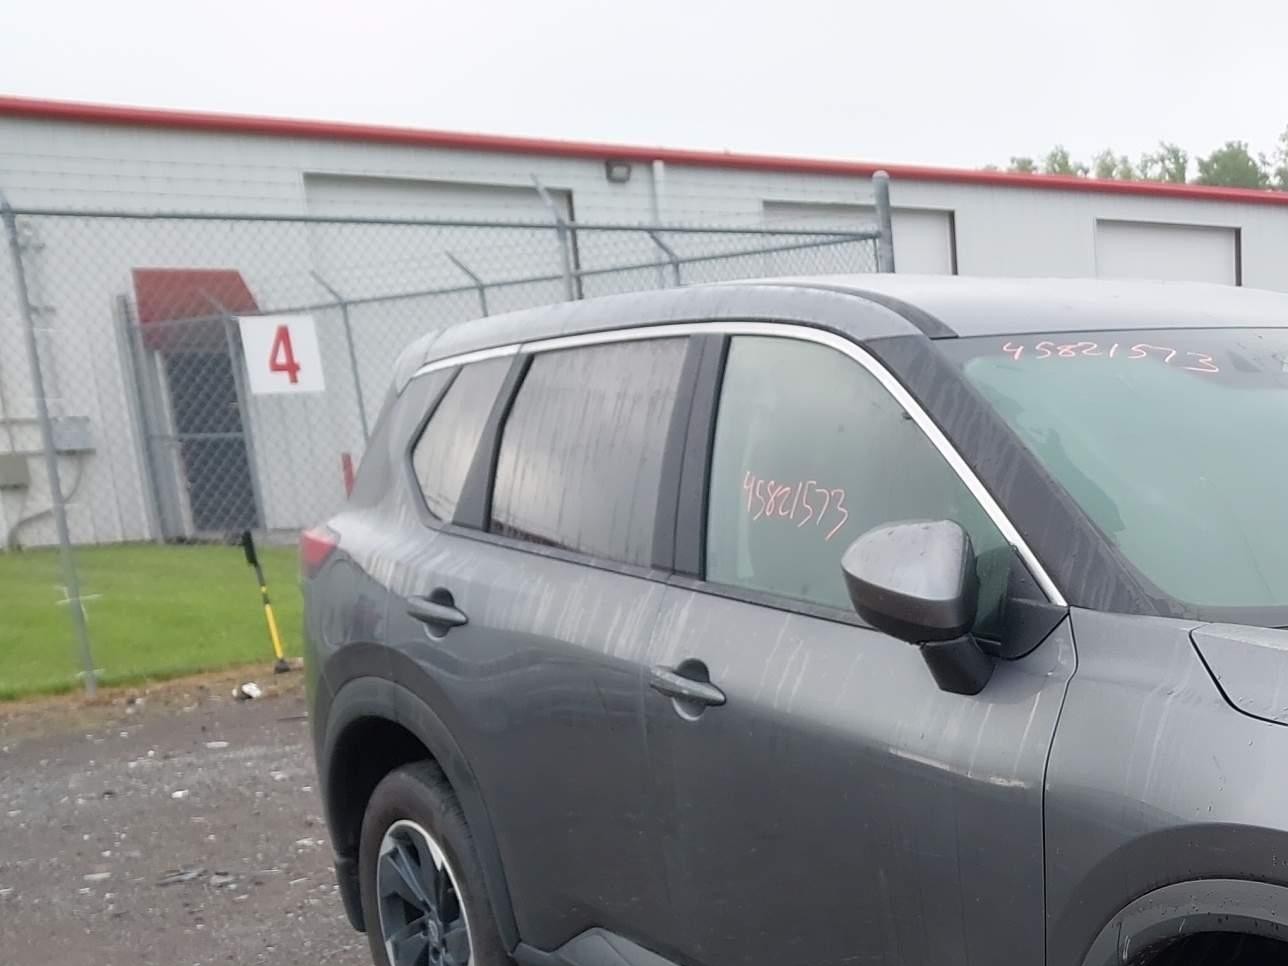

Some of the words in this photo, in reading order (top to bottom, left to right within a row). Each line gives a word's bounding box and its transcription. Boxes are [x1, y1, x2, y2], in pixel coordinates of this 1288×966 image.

[269, 324, 301, 384] 4
[1002, 341, 1220, 373] 45821573
[743, 470, 849, 541] 45821573
